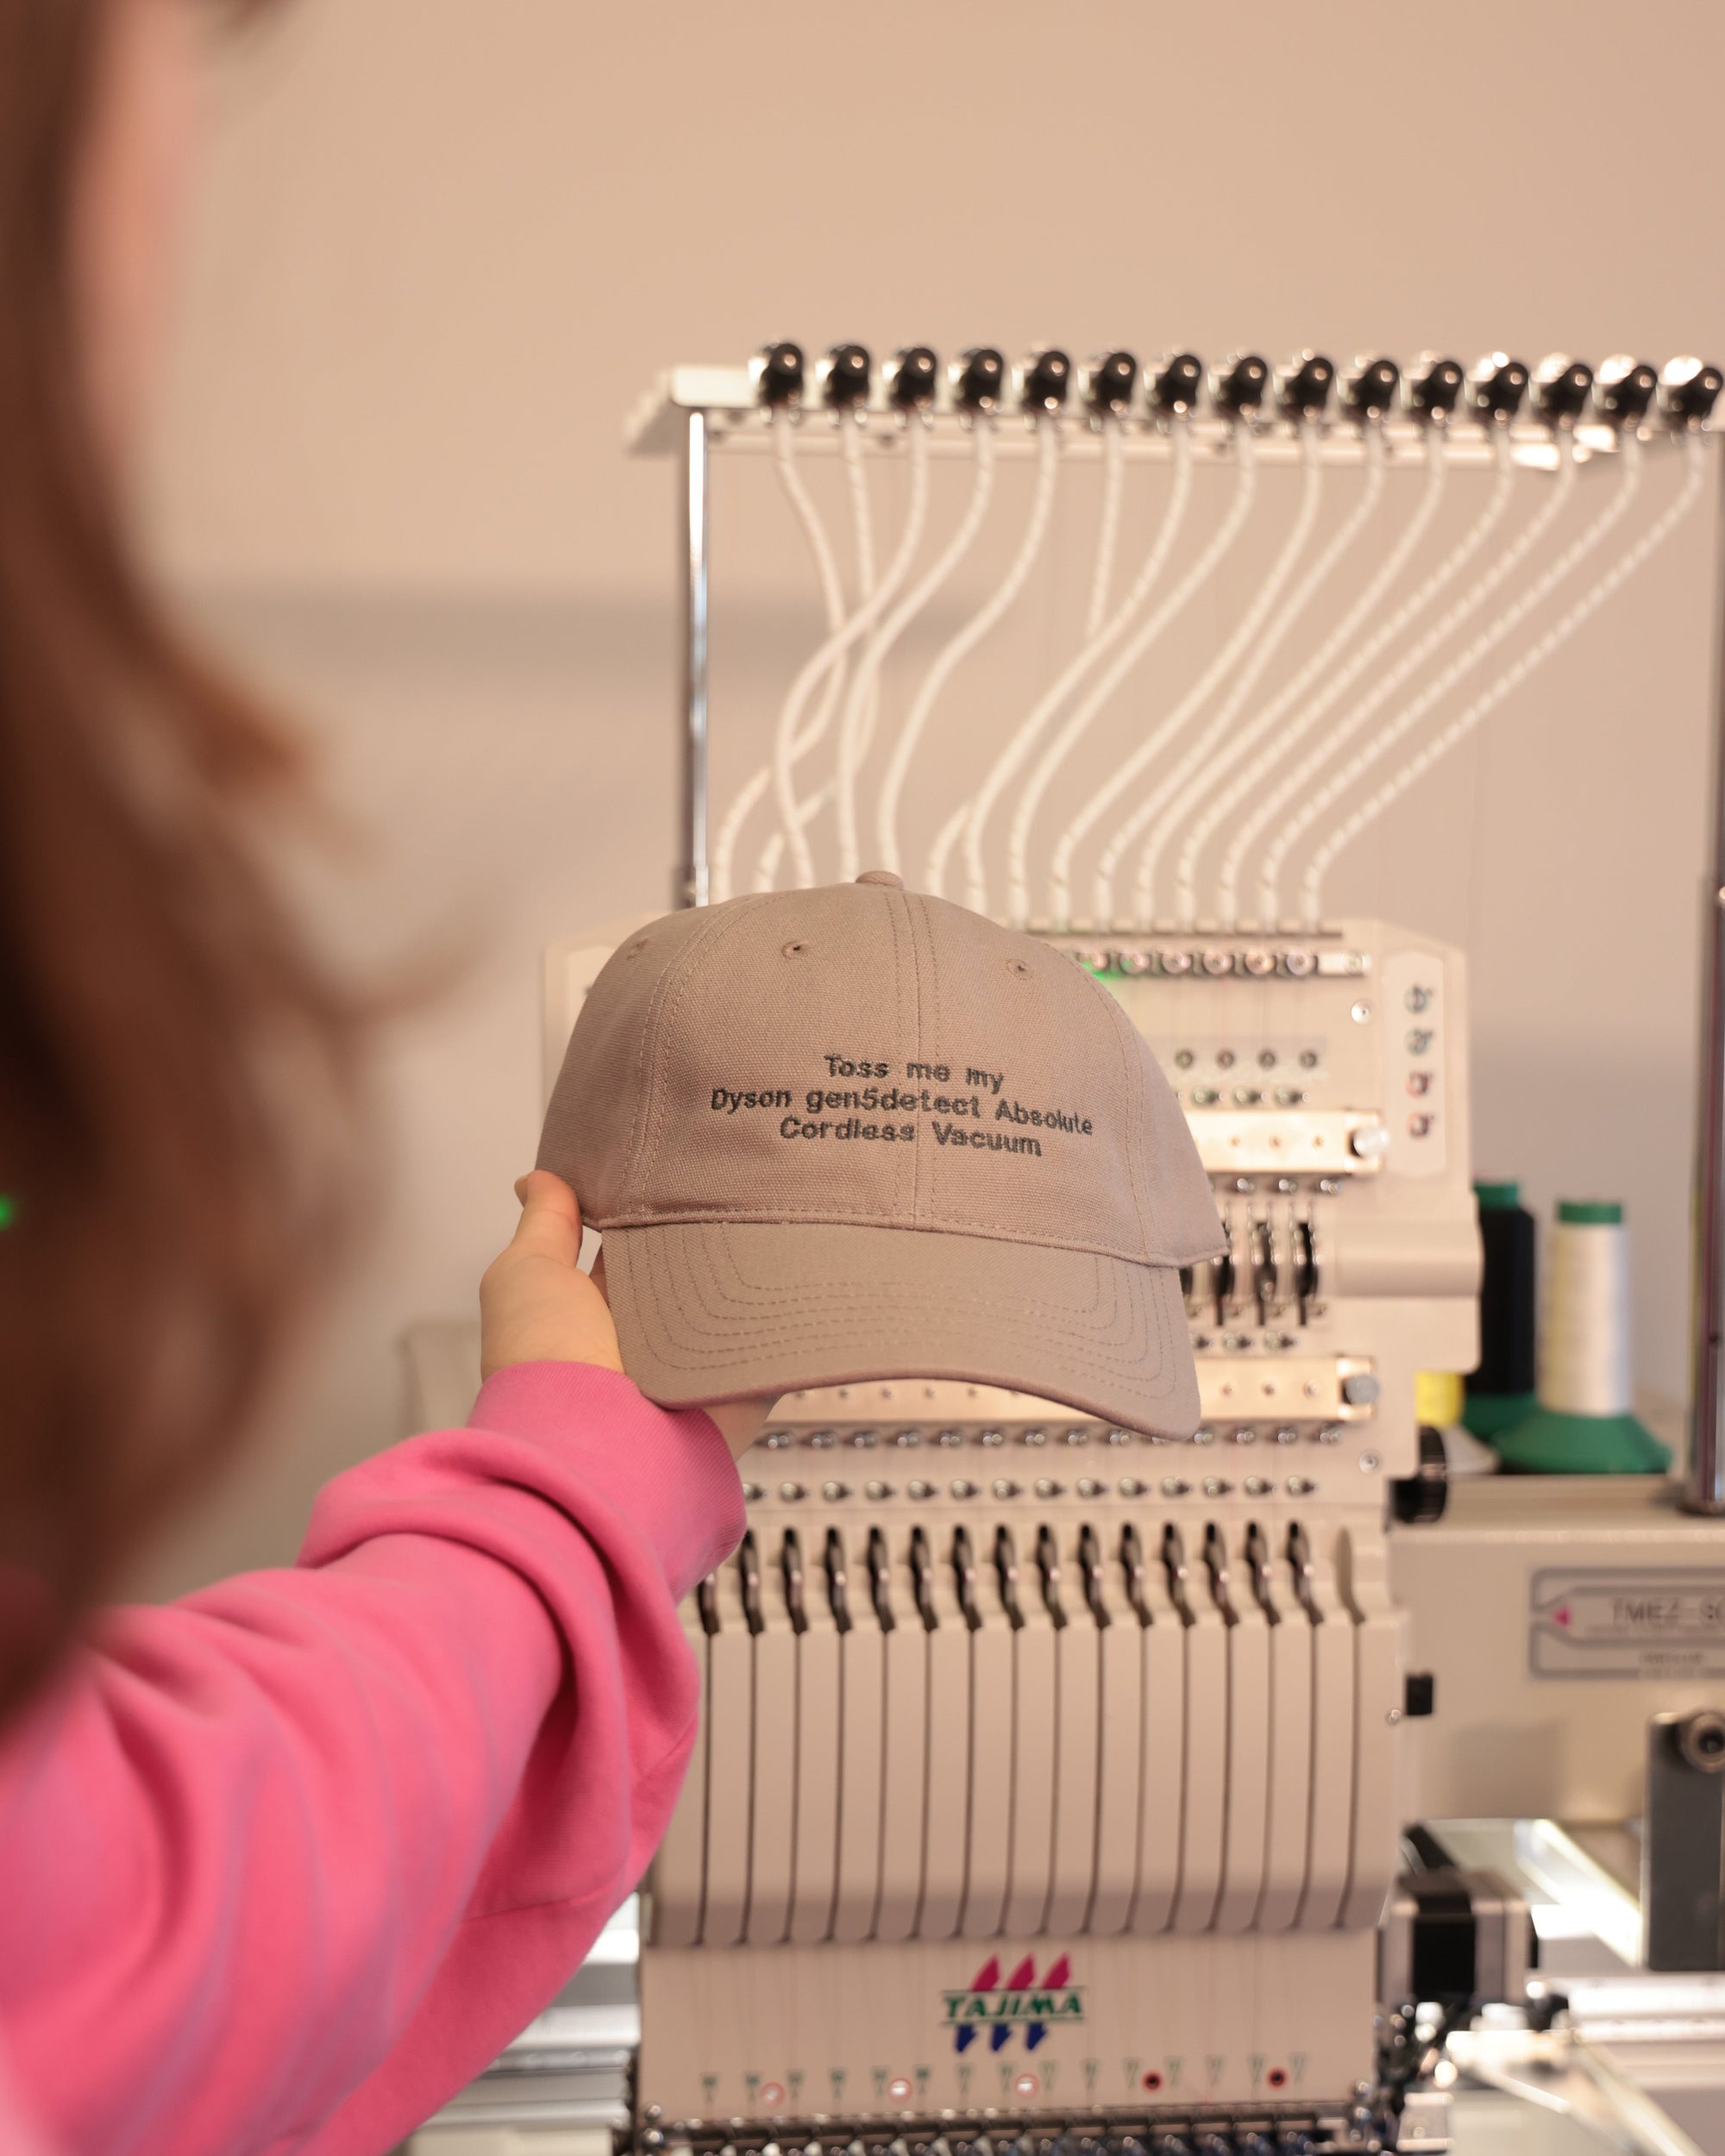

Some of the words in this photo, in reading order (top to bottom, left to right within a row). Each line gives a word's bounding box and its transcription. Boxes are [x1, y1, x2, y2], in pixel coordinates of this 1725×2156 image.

[825, 1053, 889, 1078] Toss
[906, 1062, 950, 1082] me
[966, 1068, 1004, 1094] my
[712, 1087, 792, 1114] Dyson
[806, 1087, 980, 1118] gen5detect
[994, 1098, 1093, 1136] Absolute
[780, 1115, 915, 1141] Cordless
[932, 1121, 1042, 1156] Vacuum
[944, 1993, 1082, 2018] TAJIMA
